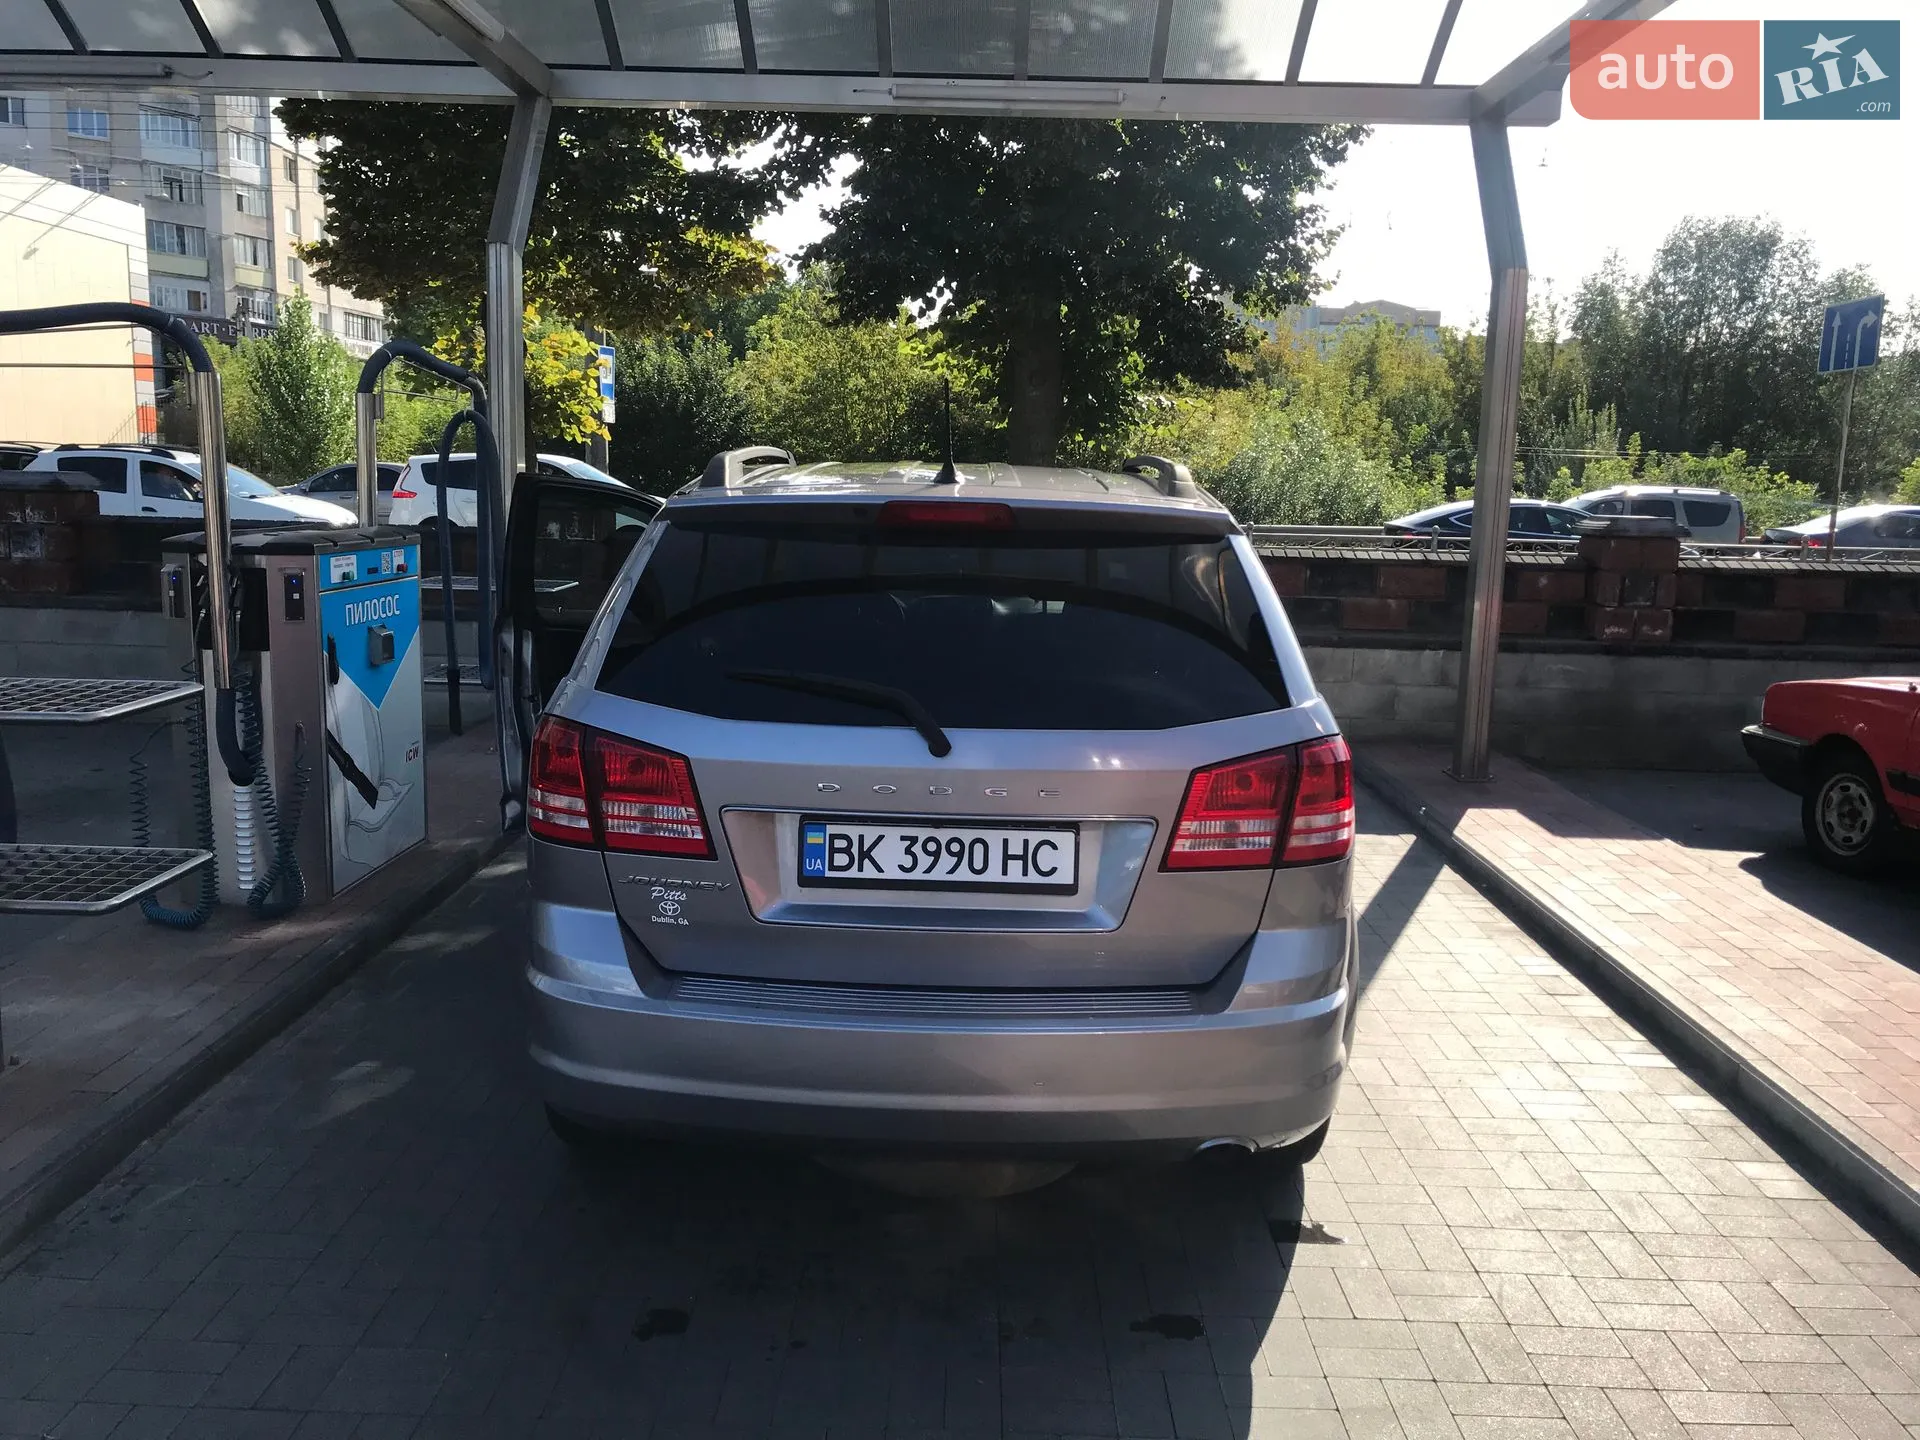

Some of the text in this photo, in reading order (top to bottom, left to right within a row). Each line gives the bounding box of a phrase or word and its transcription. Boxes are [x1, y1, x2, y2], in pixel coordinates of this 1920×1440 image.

[227, 324, 280, 343] ERESS
[345, 594, 401, 627] ПИЛОСОС
[816, 782, 1062, 799] DODGE
[827, 832, 1059, 878] BK 3990 HC
[805, 858, 823, 871] UA
[617, 875, 731, 891] JOURNEY
[650, 886, 688, 901] Pitts
[651, 914, 690, 926] Dublin, GA
